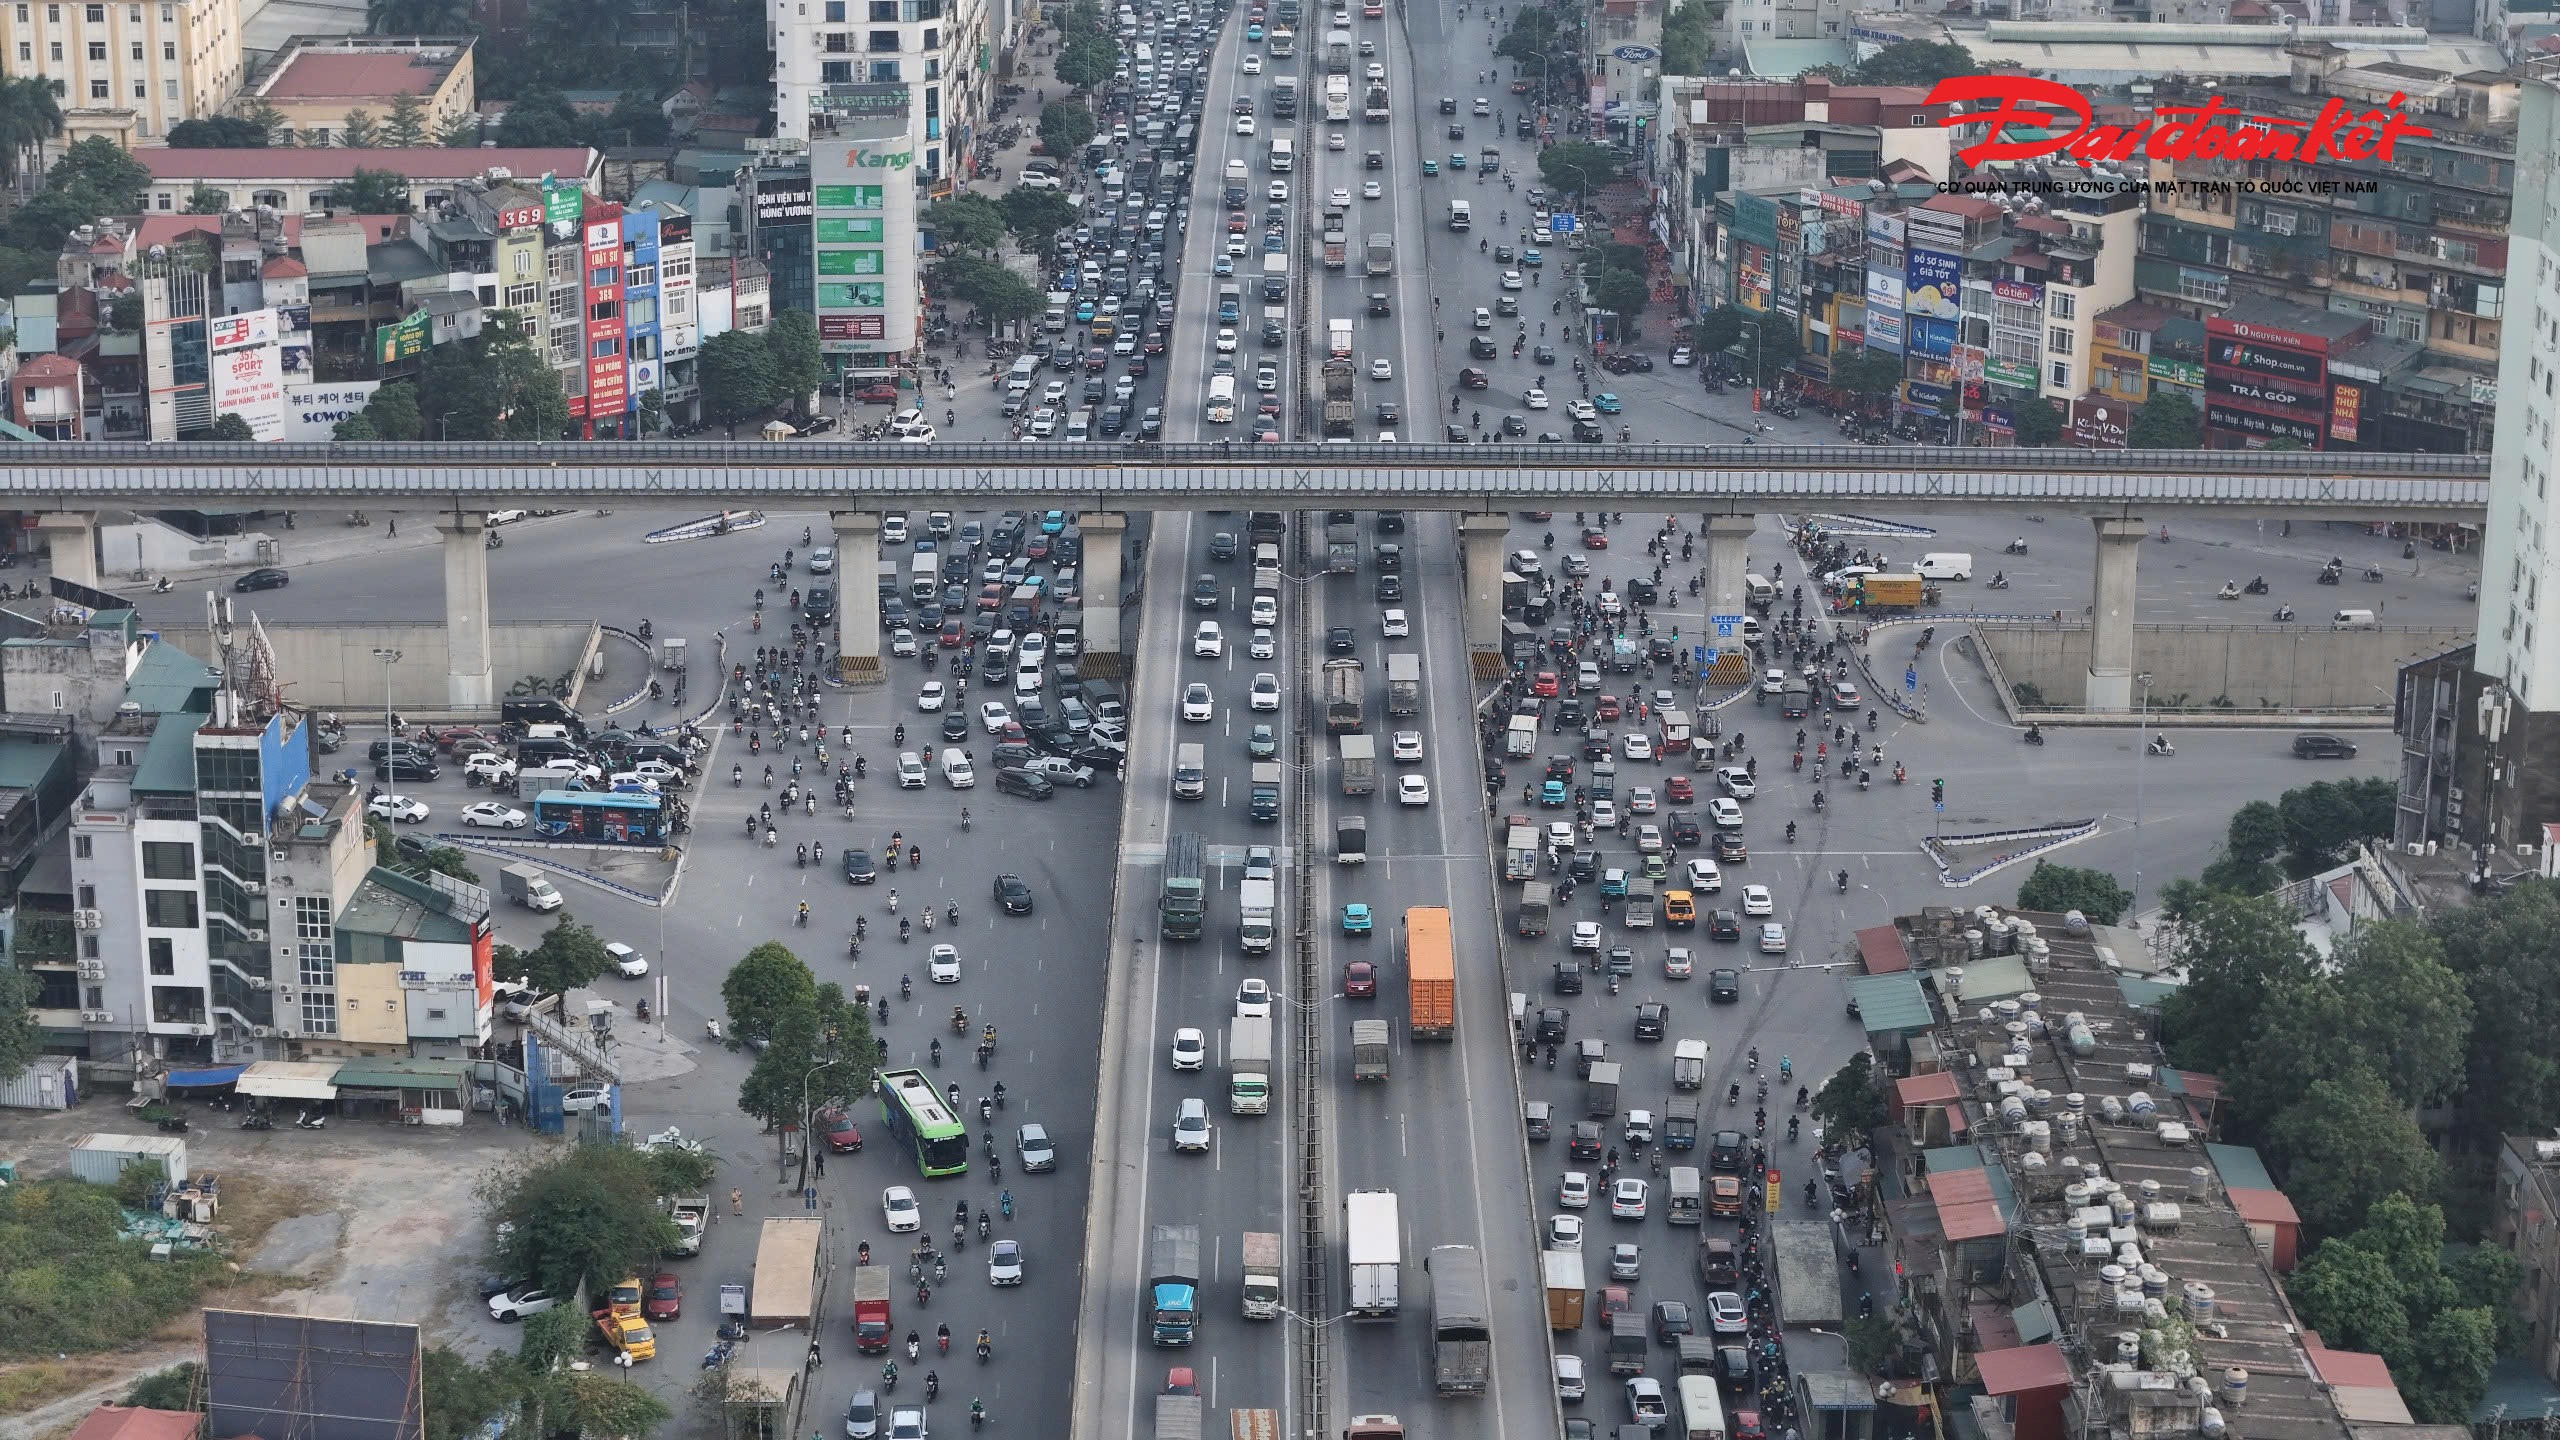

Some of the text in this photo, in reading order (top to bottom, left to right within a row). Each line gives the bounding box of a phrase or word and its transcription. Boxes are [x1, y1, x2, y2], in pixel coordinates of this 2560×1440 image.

[1621, 48, 1647, 59] Ford
[757, 193, 776, 206] BỆNH
[776, 191, 792, 204] VIỆN
[760, 206, 812, 218] HÙNG VƯƠNG
[2233, 324, 2249, 336] 10
[231, 360, 263, 373] SPORT
[2253, 355, 2305, 373] Shop.com.vn
[2336, 387, 2358, 397] CHO
[2336, 397, 2357, 408] THUÊ
[2335, 408, 2354, 418] NHÀ
